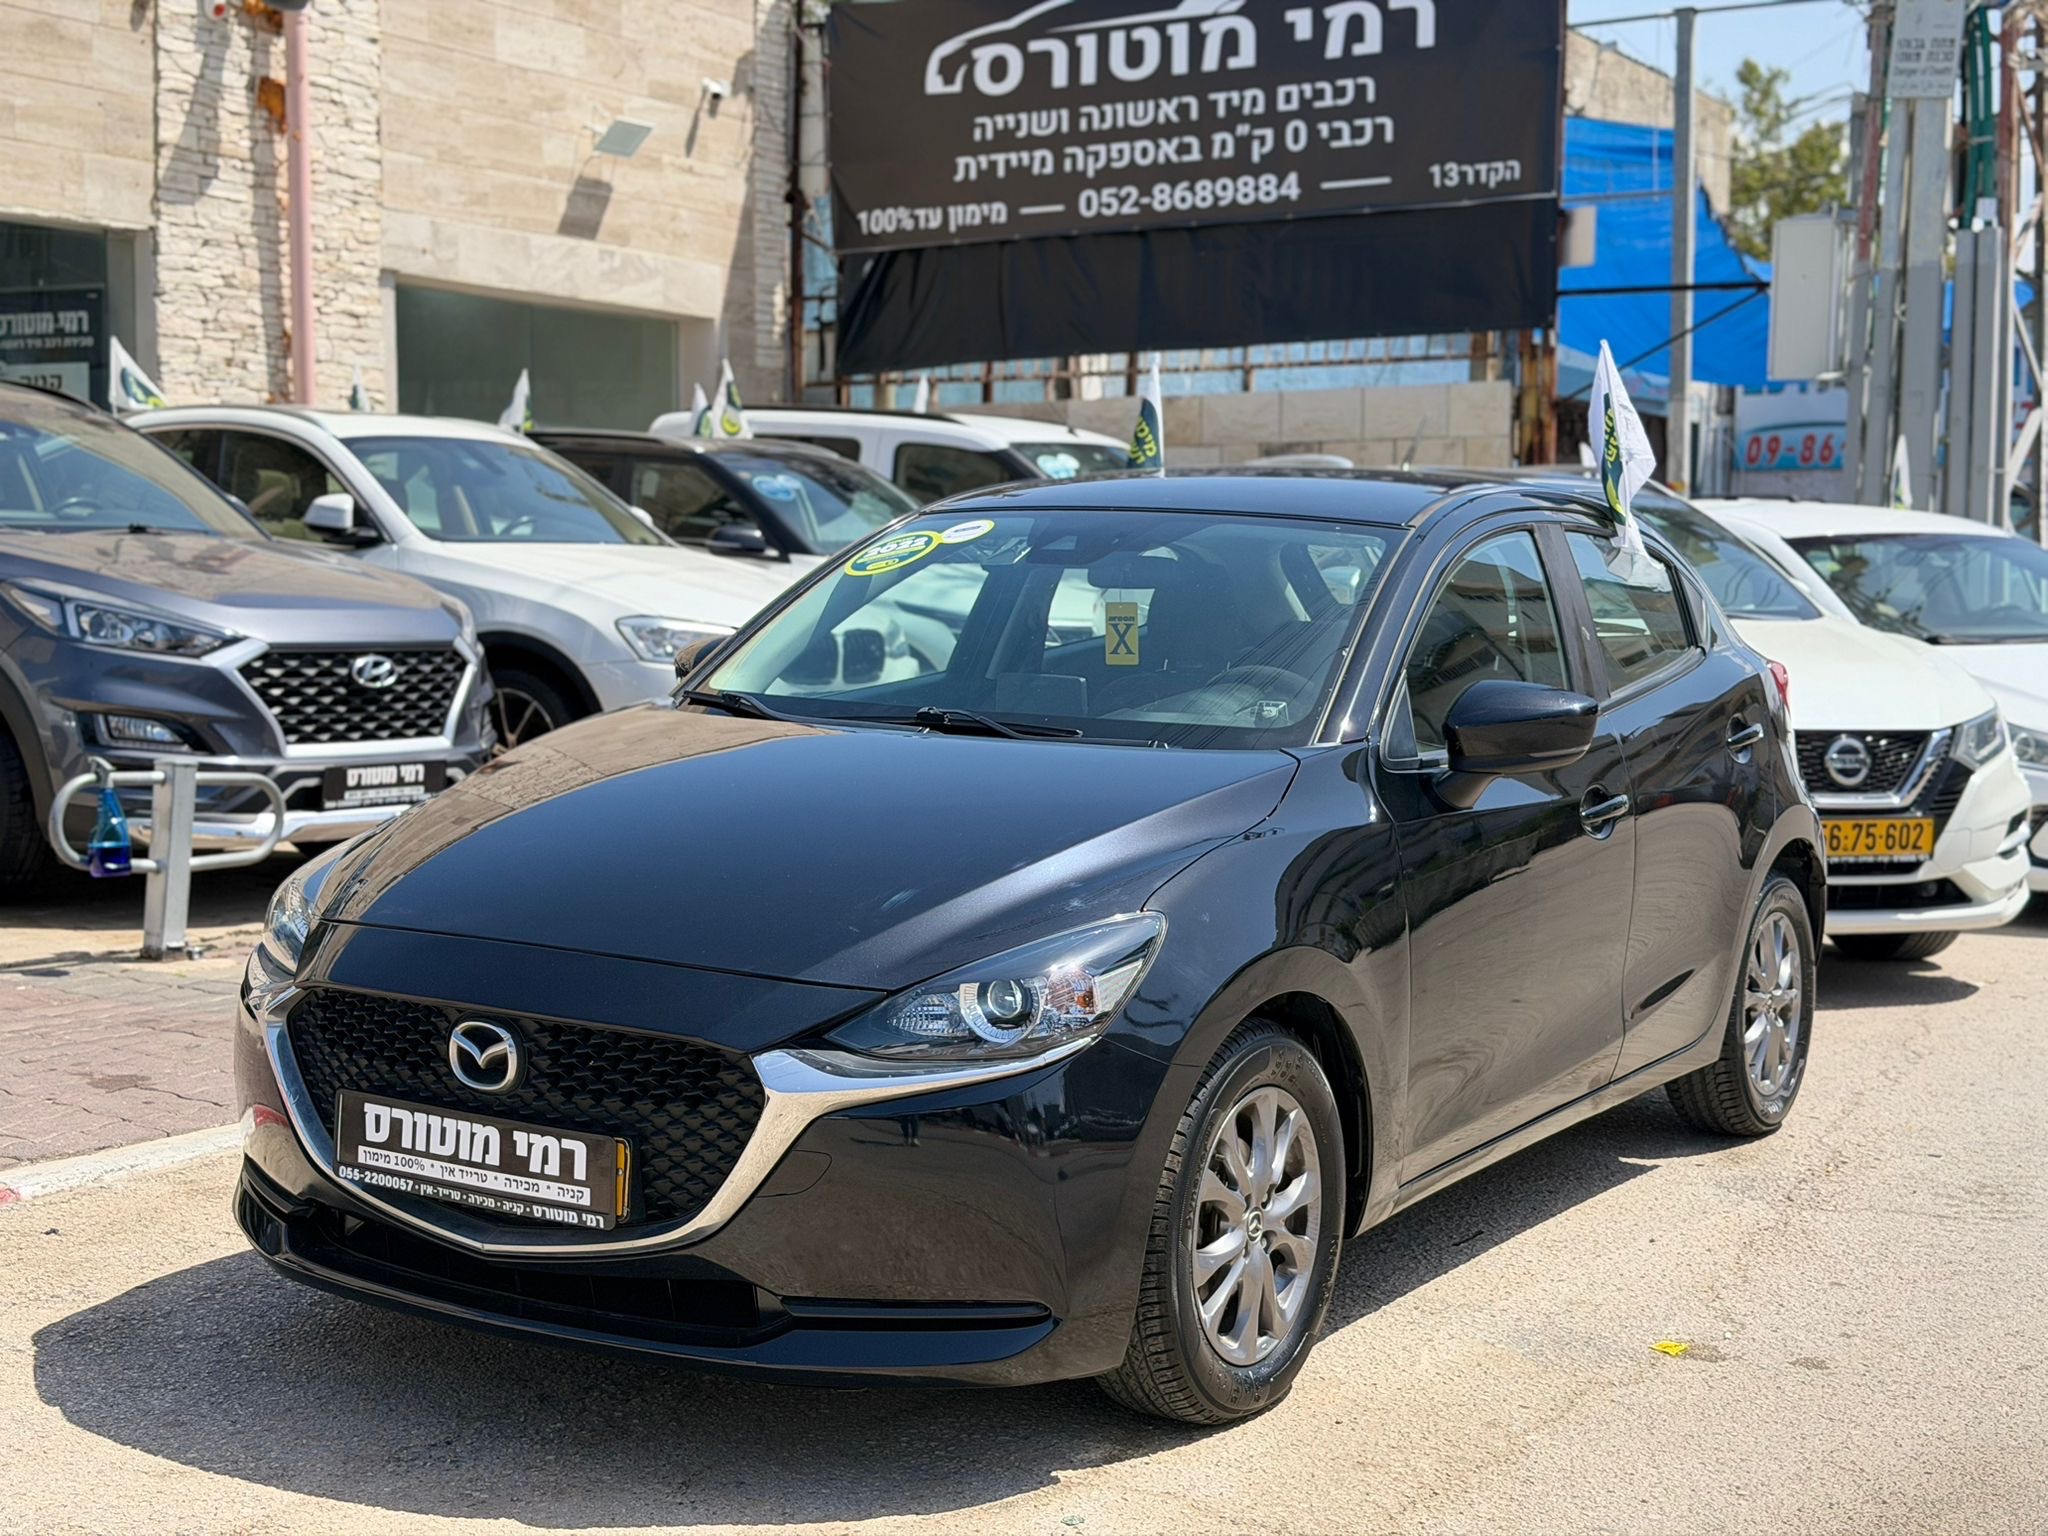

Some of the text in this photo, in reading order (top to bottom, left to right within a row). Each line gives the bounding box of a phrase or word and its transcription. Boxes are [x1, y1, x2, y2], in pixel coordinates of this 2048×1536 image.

[970, 0, 1435, 97] רמי מוטורס
[972, 76, 1376, 143] רכבים מיד ראשונה ושנייה
[1285, 119, 1308, 152] 0
[1317, 115, 1394, 149] רכבי
[953, 148, 1055, 183] מיידית
[1062, 134, 1202, 180] באספקה
[1078, 171, 1301, 219] 052-8689884
[947, 201, 1007, 233] מימון
[1746, 433, 1846, 465] 09-86
[1108, 623, 1136, 655] X
[363, 1149, 391, 1164] מימון
[364, 1102, 587, 1181] רמי מוטורס
[339, 1165, 414, 1192] 055-2200057
[440, 1164, 456, 1178] אין
[458, 1170, 488, 1184] טרייד
[504, 1176, 540, 1193] מכירה
[468, 1193, 495, 1208] מכירה
[502, 1200, 524, 1215] קניה
[557, 1186, 584, 1203] קניה
[532, 1204, 579, 1224] מוטורס
[582, 1213, 605, 1229] רמי
